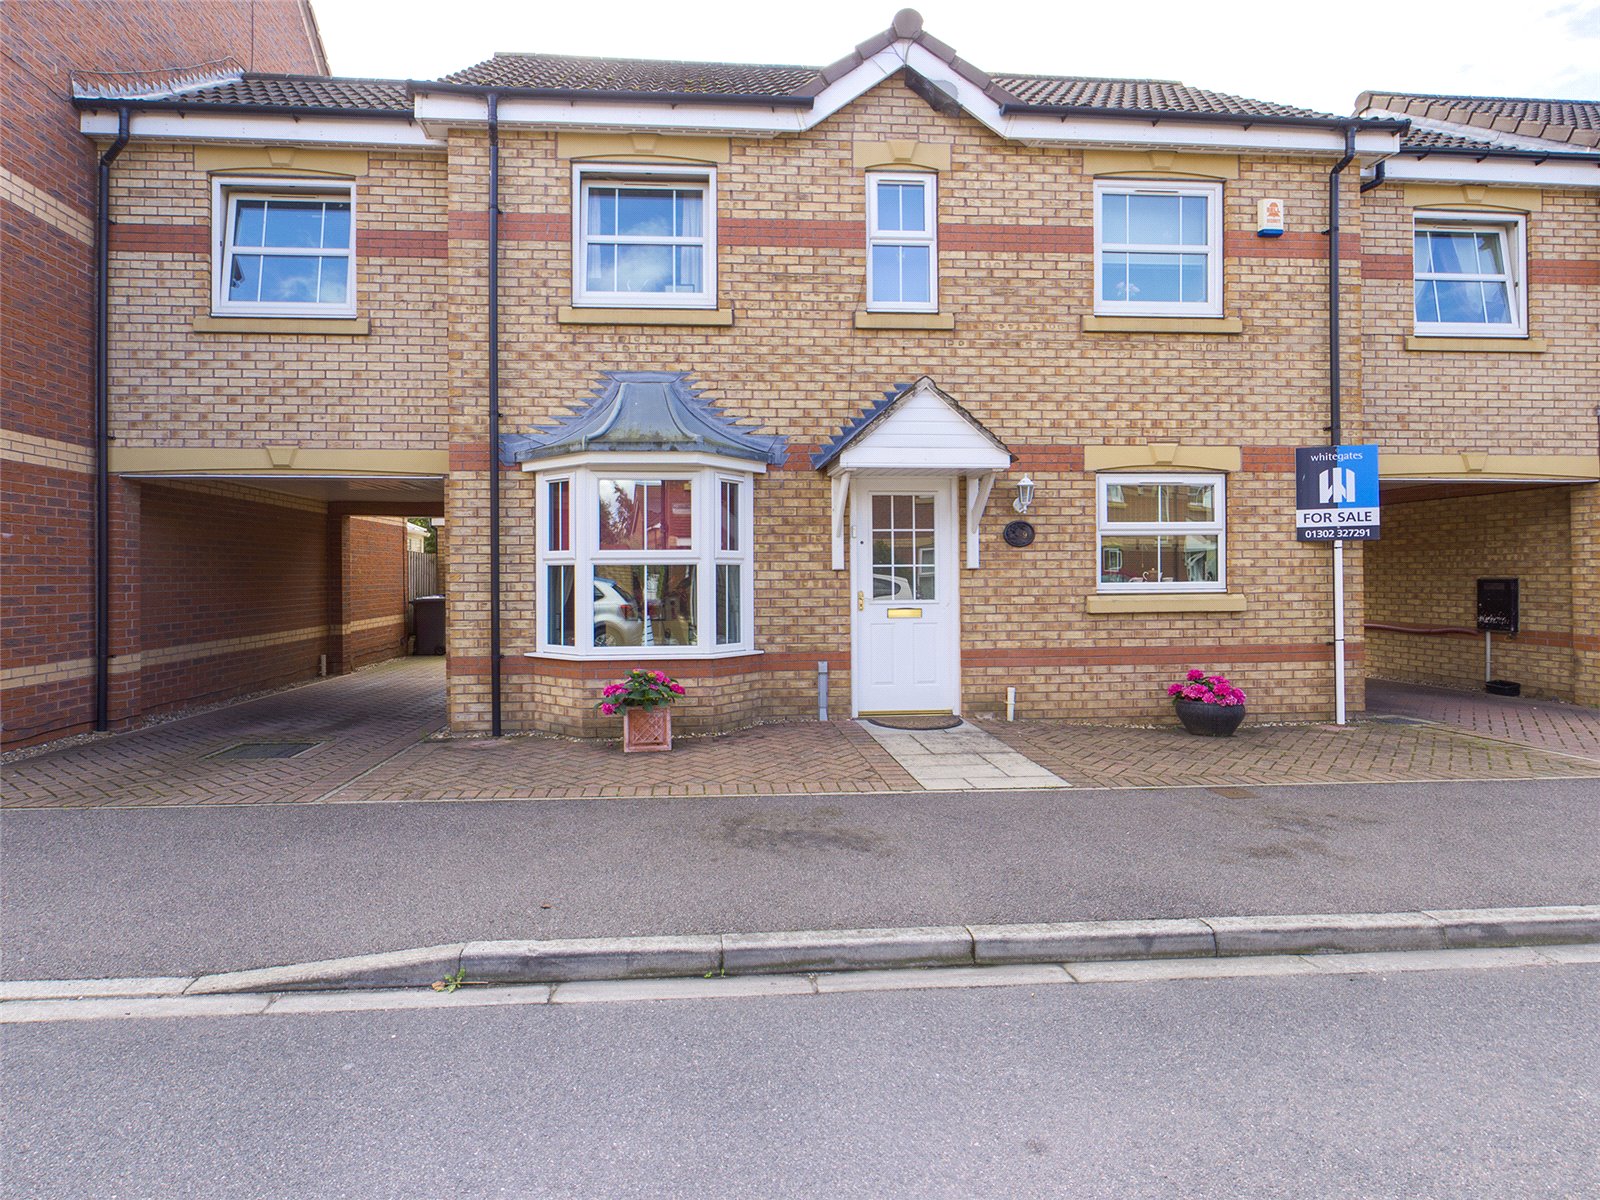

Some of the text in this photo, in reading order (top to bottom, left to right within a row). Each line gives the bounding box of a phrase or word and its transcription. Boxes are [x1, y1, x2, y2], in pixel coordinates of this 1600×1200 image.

[1310, 452, 1363, 462] whitegates
[1303, 511, 1372, 524] FOR SALE
[1305, 528, 1371, 539] 01302 327291
